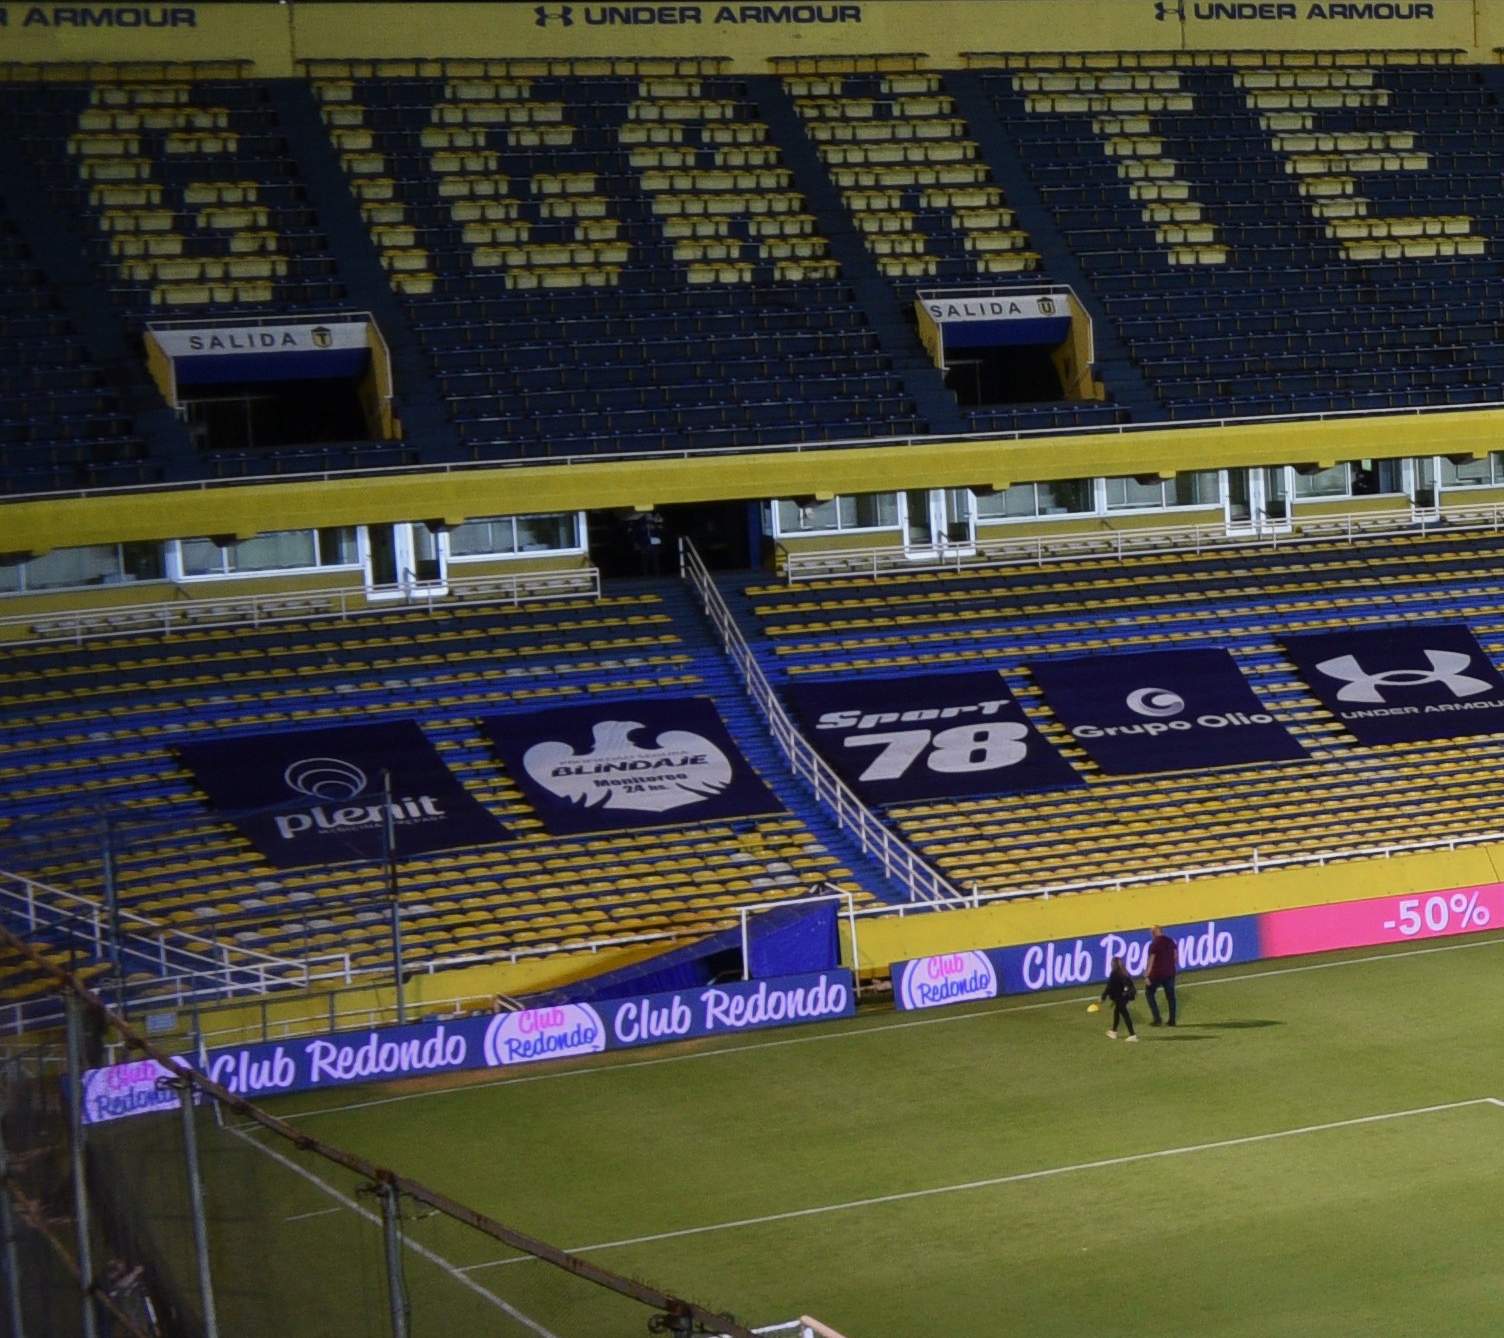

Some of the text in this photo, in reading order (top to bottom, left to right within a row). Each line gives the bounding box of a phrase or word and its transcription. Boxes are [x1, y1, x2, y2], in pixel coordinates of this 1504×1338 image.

[23, 7, 198, 27] ARMOUR
[584, 6, 863, 25] UNDER ARMOUR
[1194, 3, 1434, 20] UNDER ARMOUR
[930, 302, 1022, 319] SALIDA
[190, 332, 299, 351] SALIDA
[815, 699, 1011, 731] Sport
[1072, 711, 1273, 738] Grupo Olio
[1340, 706, 1421, 721] UNDER
[844, 721, 1029, 782] 78
[551, 754, 710, 778] BLINDAJE
[274, 795, 447, 840] plenit
[1383, 893, 1490, 936] -50%
[927, 951, 965, 979] Club
[1022, 940, 1092, 990] Club
[917, 975, 993, 1005] Redondo
[518, 1006, 565, 1034] Club
[615, 974, 847, 1041] Club Redondo
[504, 1021, 597, 1061] Redondo
[209, 1025, 466, 1094] Club Redondo
